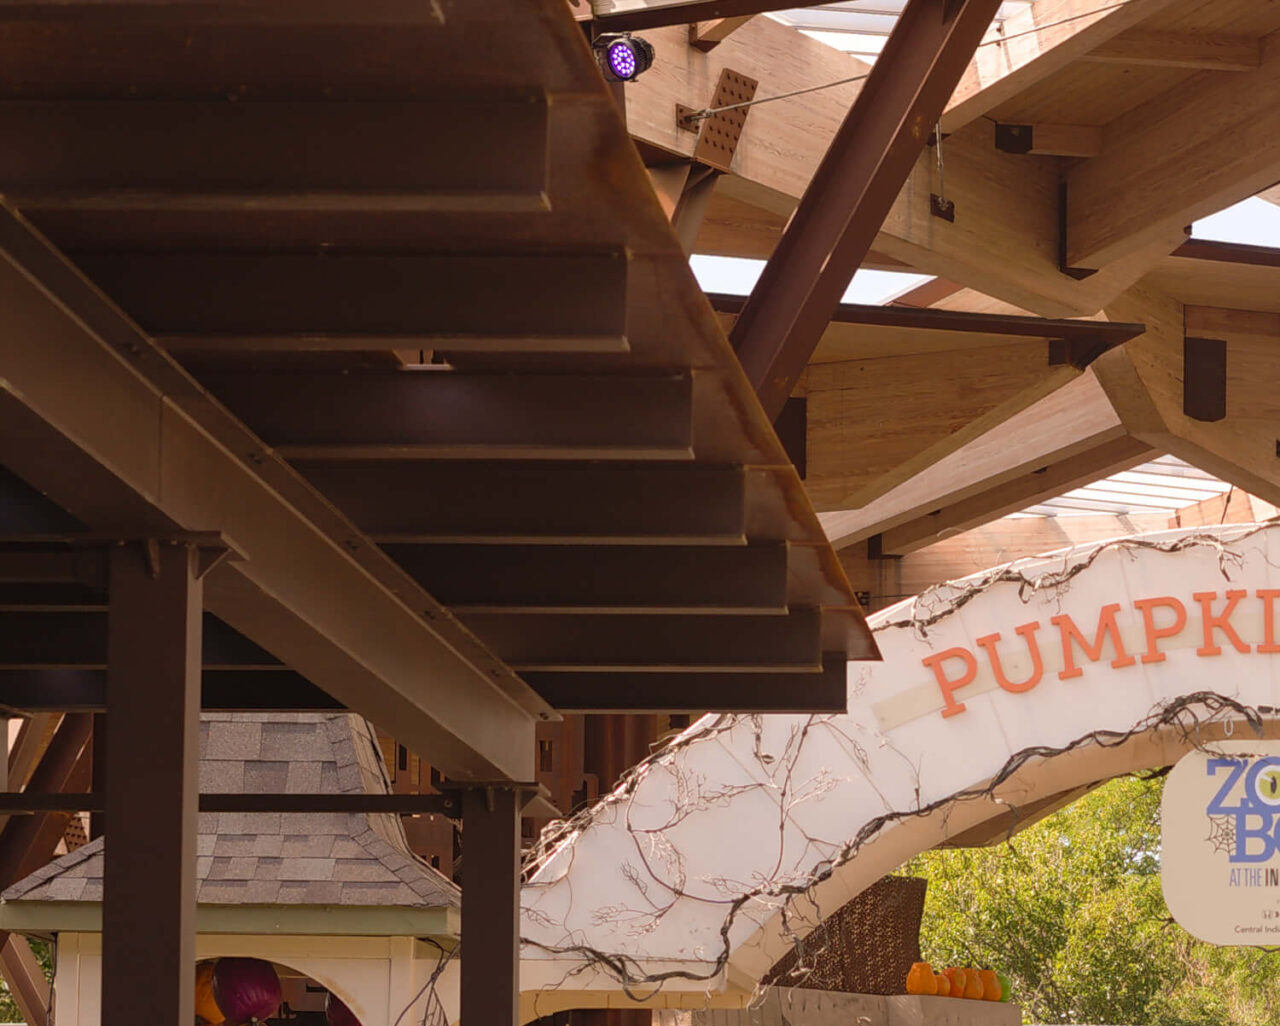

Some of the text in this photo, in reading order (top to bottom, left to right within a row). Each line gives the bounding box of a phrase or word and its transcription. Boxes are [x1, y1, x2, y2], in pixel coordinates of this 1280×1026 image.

[1229, 868, 1242, 887] AT
[1245, 868, 1262, 887] THE
[1234, 926, 1263, 934] Central
